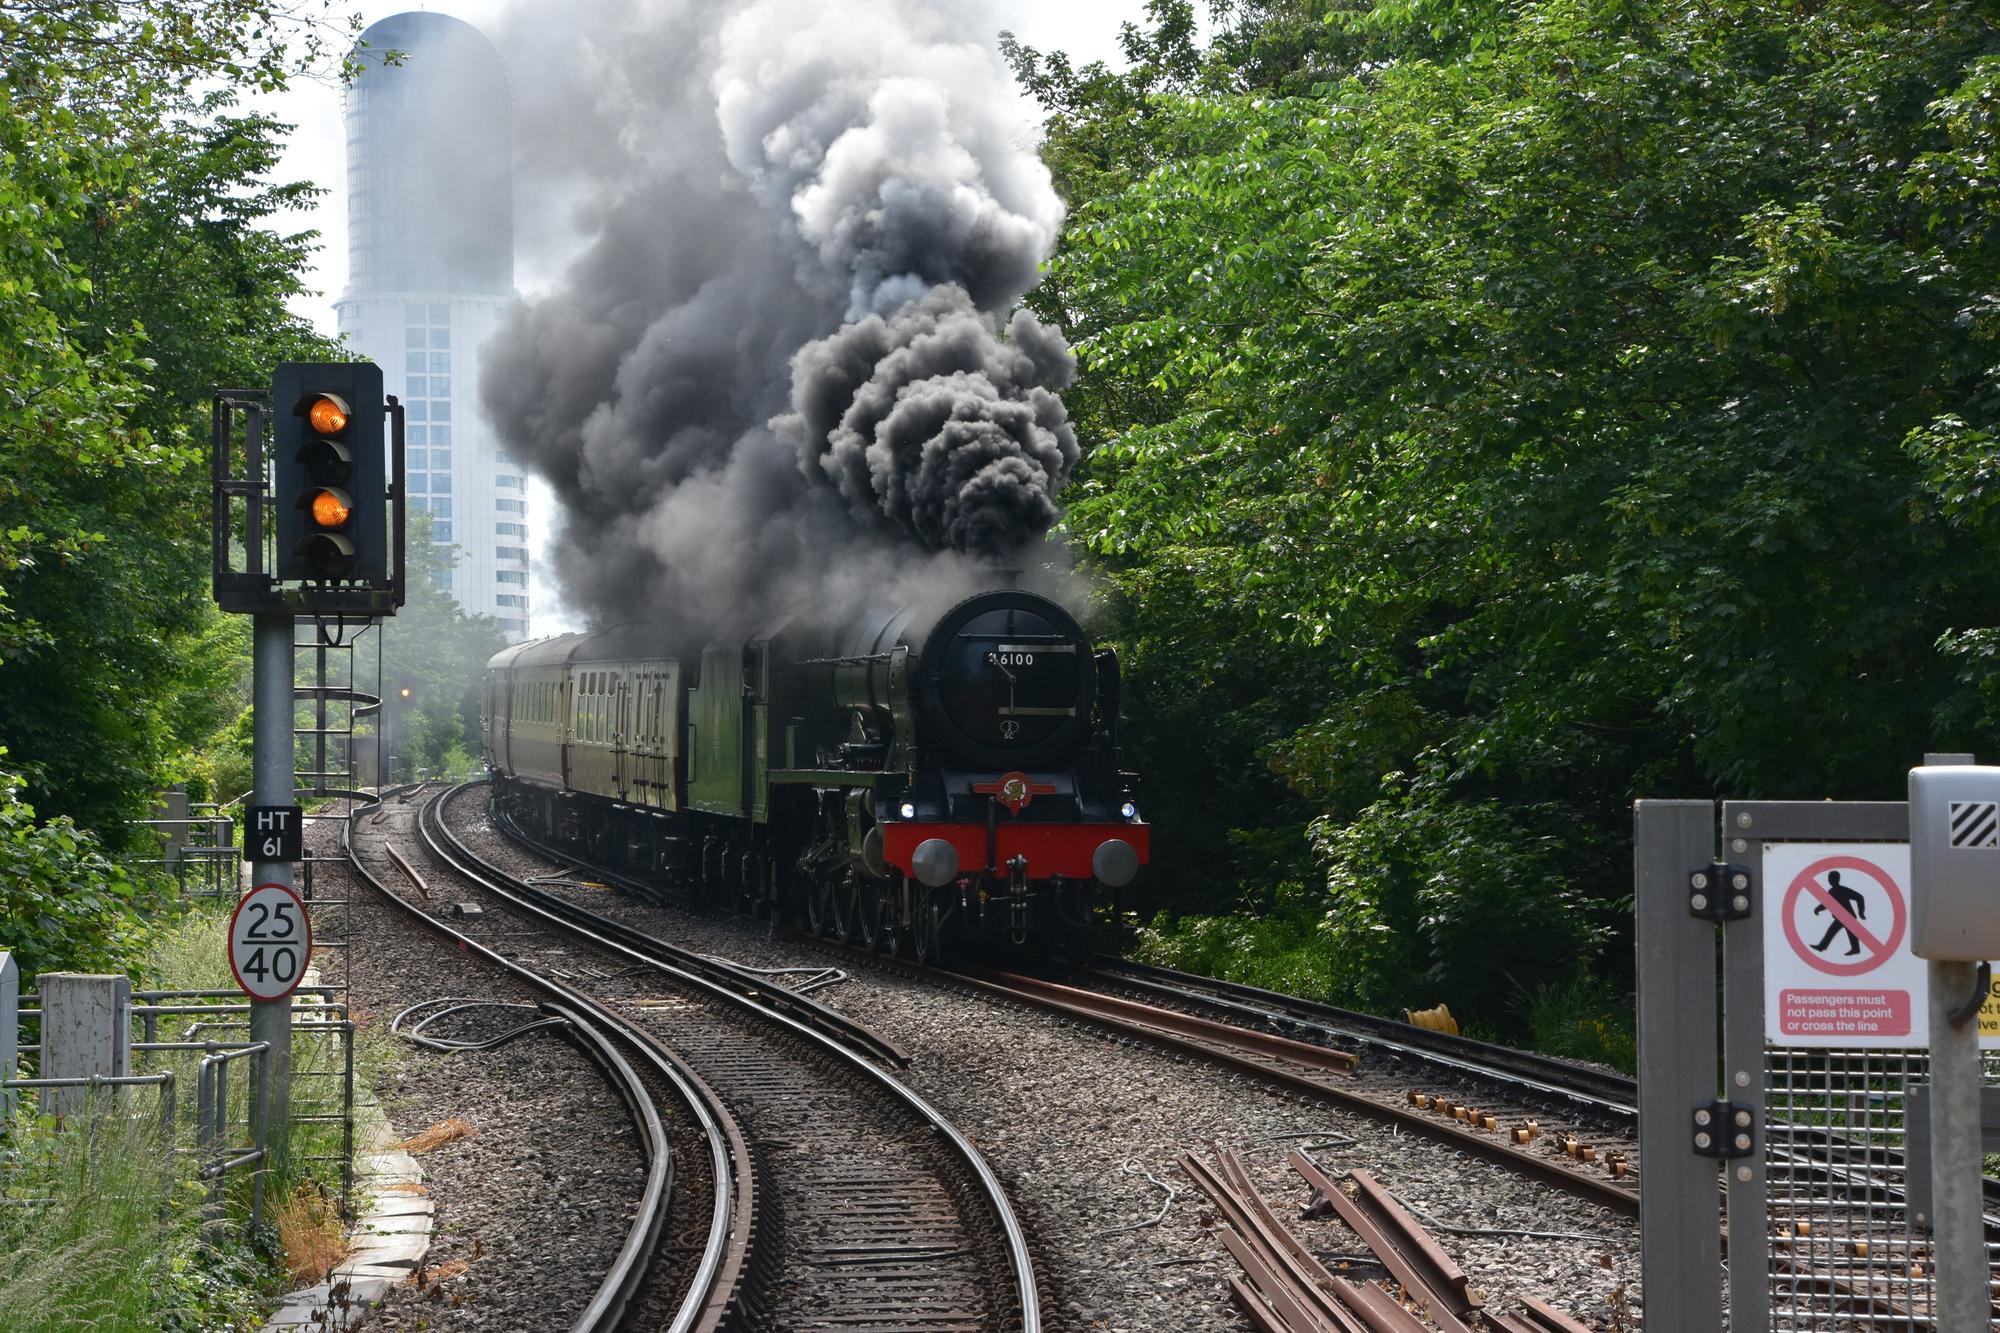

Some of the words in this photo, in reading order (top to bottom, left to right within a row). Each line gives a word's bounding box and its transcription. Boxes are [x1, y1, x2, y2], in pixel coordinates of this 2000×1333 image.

[257, 811, 290, 831] HT
[262, 837, 281, 857] 61
[247, 902, 294, 939] 25
[242, 947, 297, 983] 40
[1787, 994, 1854, 1006] Passengers
[1856, 994, 1886, 1005] must
[1787, 1008, 1806, 1017] not
[1808, 1009, 1837, 1019] pass
[1838, 1008, 1861, 1018] this
[1862, 1008, 1893, 1019] point
[1979, 1003, 1993, 1014] ot
[1787, 1022, 1800, 1031] or
[1801, 1022, 1834, 1031] cross
[1836, 1021, 1855, 1031] the
[1857, 1021, 1879, 1031] line
[1978, 1018, 1998, 1030] ive
